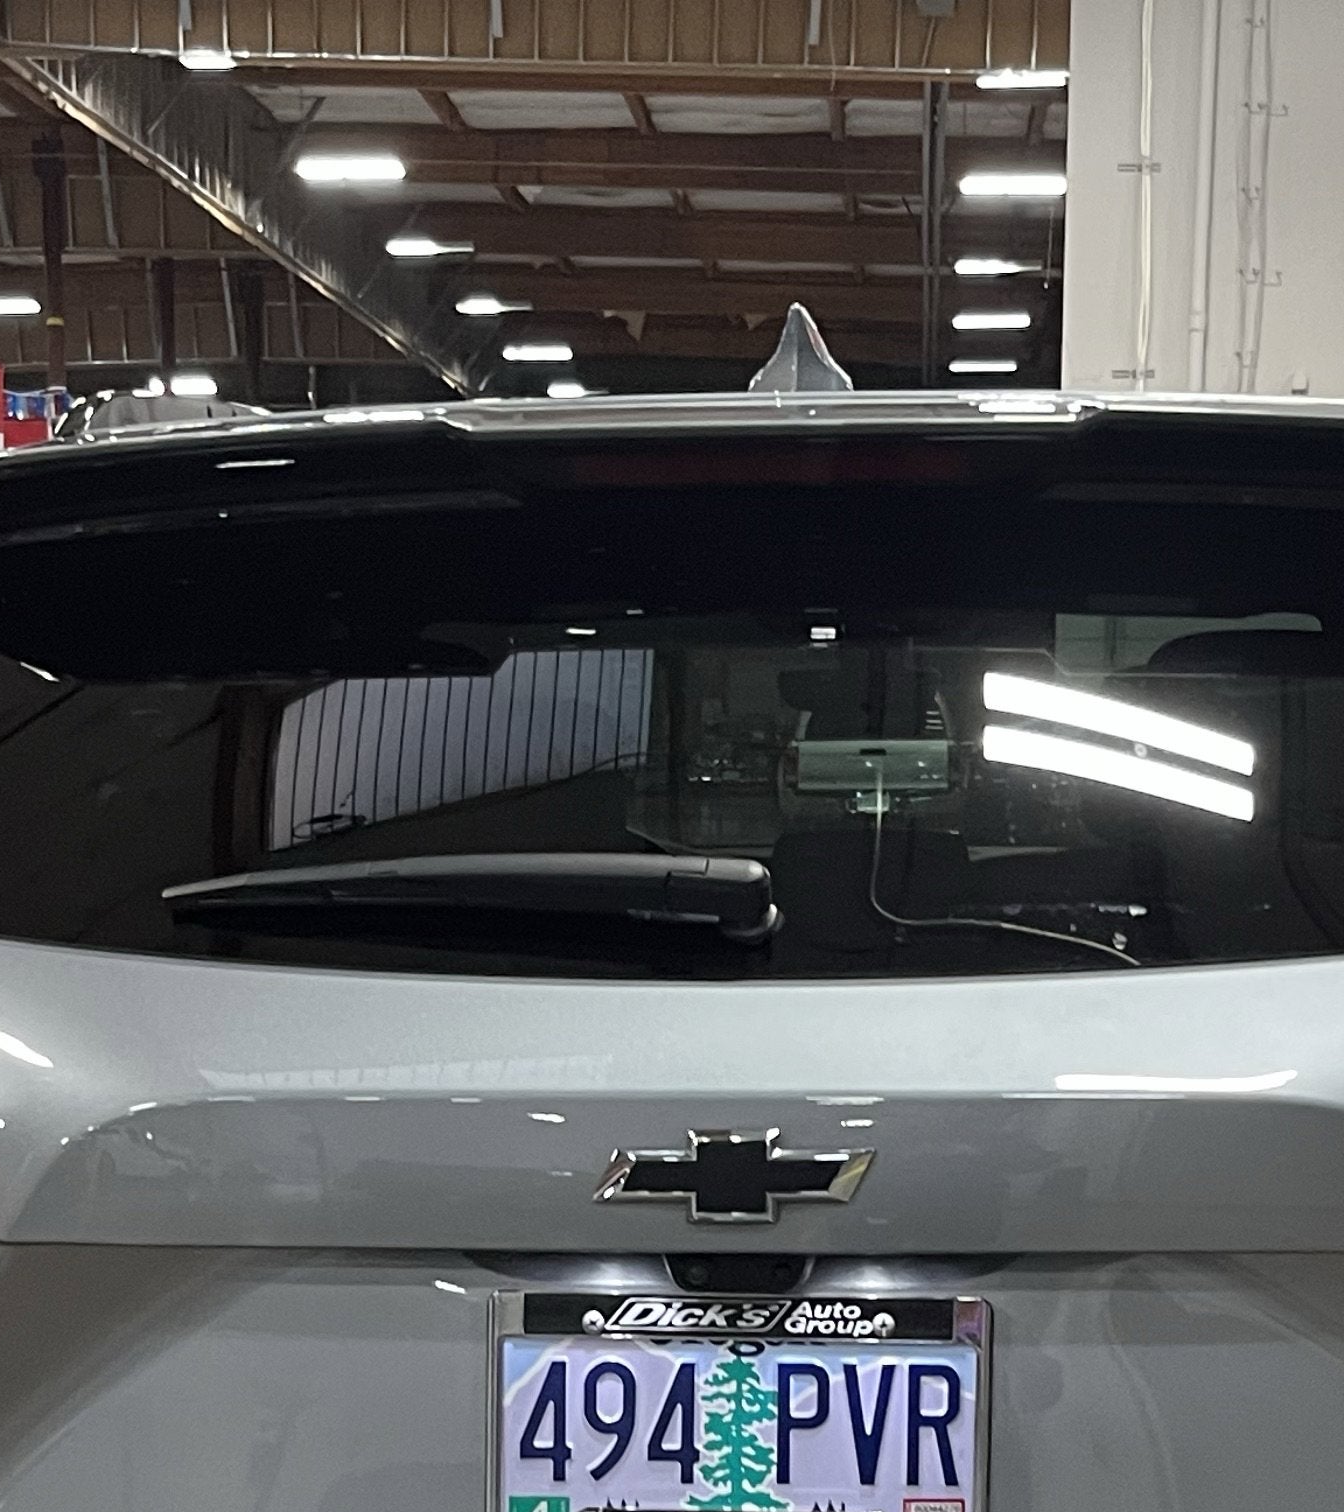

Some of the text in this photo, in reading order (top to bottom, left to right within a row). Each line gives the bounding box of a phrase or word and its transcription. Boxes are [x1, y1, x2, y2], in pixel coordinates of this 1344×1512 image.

[619, 1303, 780, 1328] Dick's
[793, 1301, 861, 1319] Auto
[784, 1317, 874, 1337] Group
[519, 1361, 961, 1486] 494 PVR
